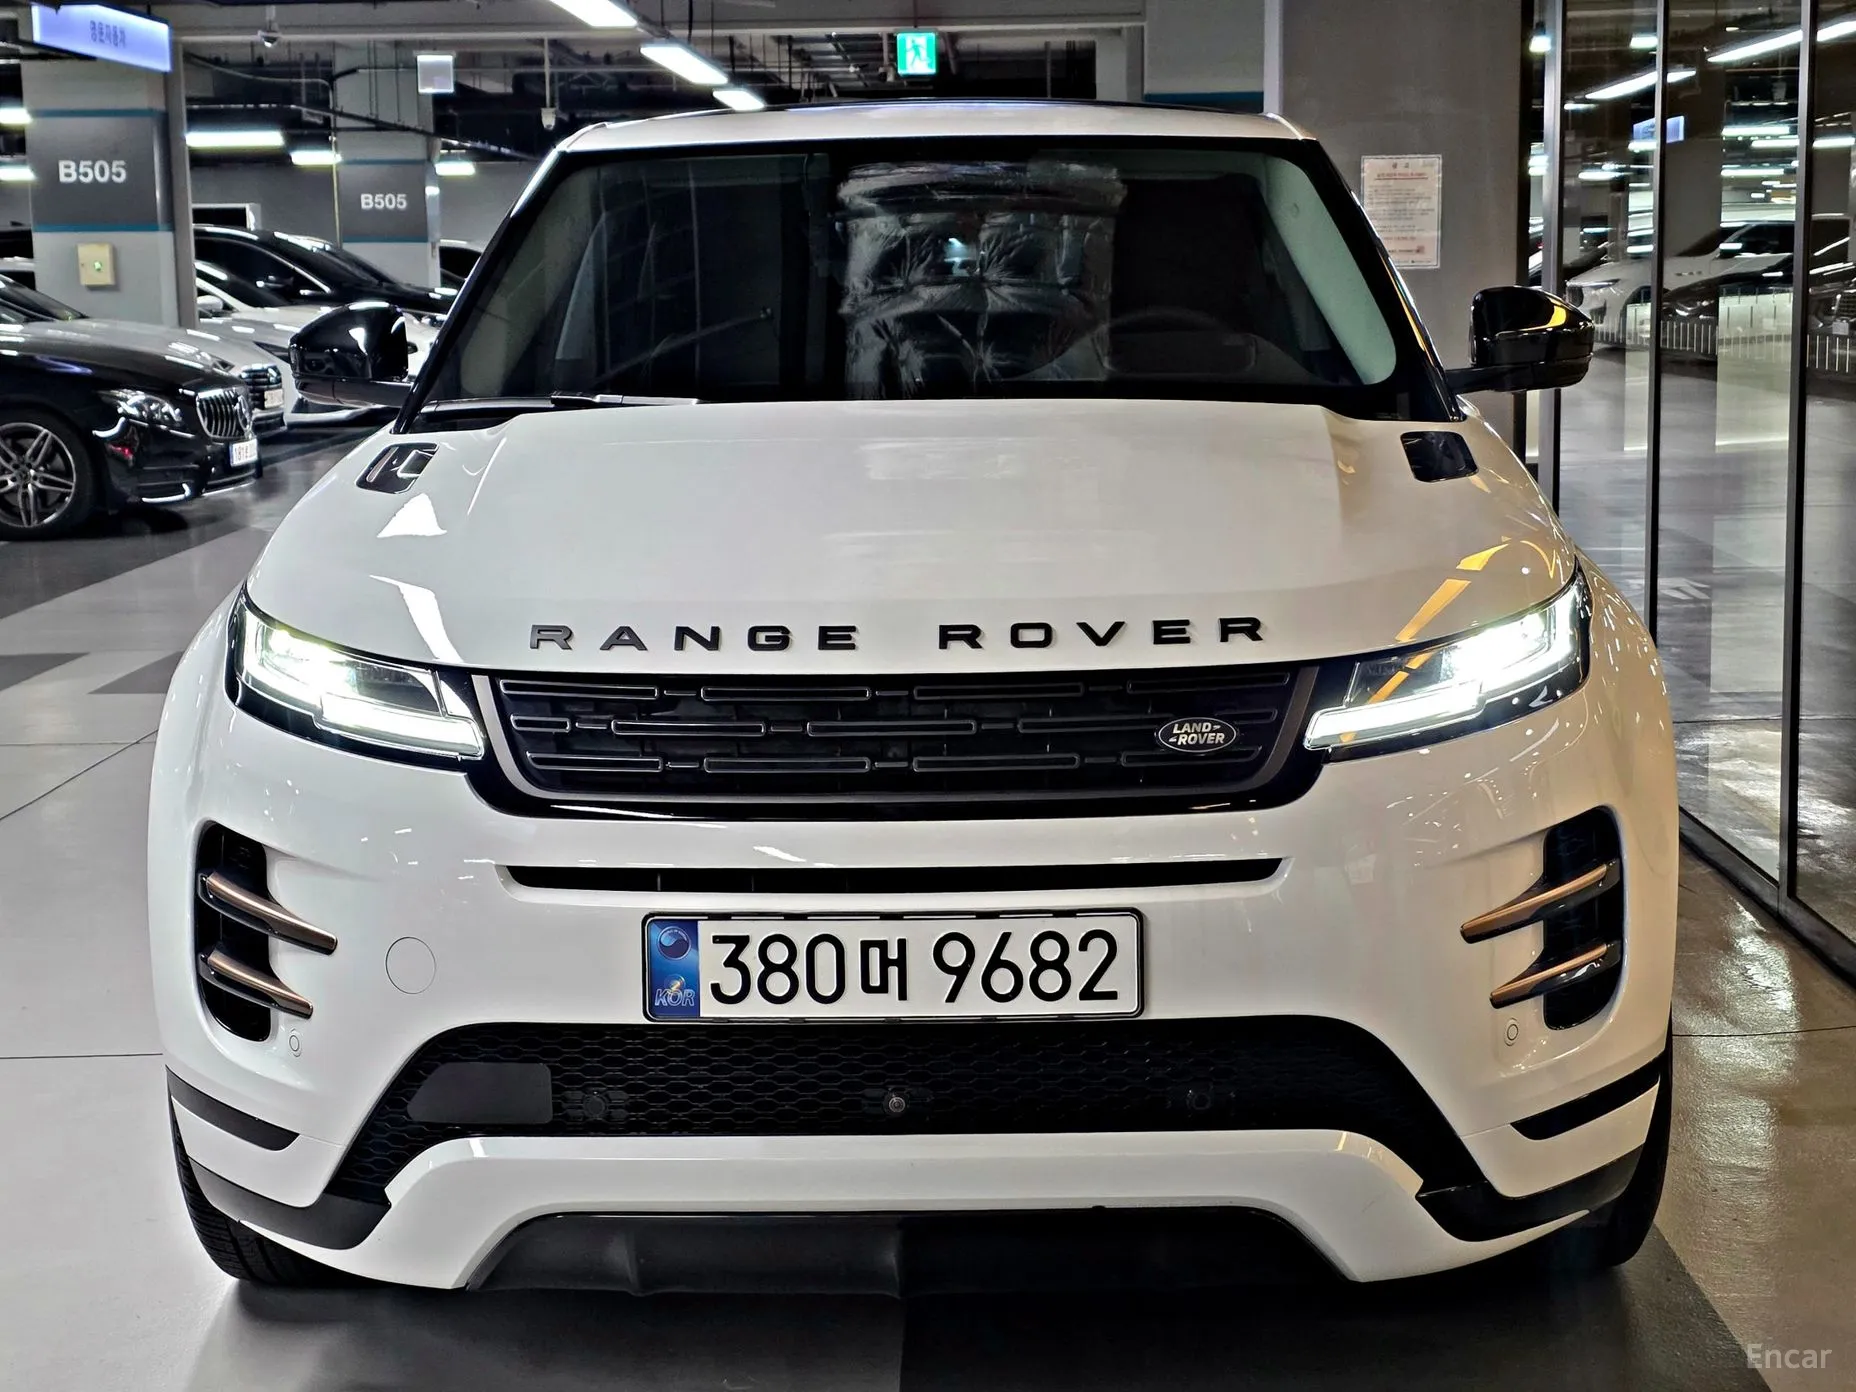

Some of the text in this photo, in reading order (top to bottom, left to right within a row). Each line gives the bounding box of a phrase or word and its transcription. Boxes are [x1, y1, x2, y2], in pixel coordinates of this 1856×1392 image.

[58, 159, 127, 183] B505
[360, 193, 408, 210] B505
[529, 616, 1264, 652] RANGE ROVER
[1173, 722, 1212, 734] LAND
[1177, 733, 1226, 746] ROVER
[709, 928, 1118, 1005] 380머 9682
[654, 988, 696, 1007] KOR
